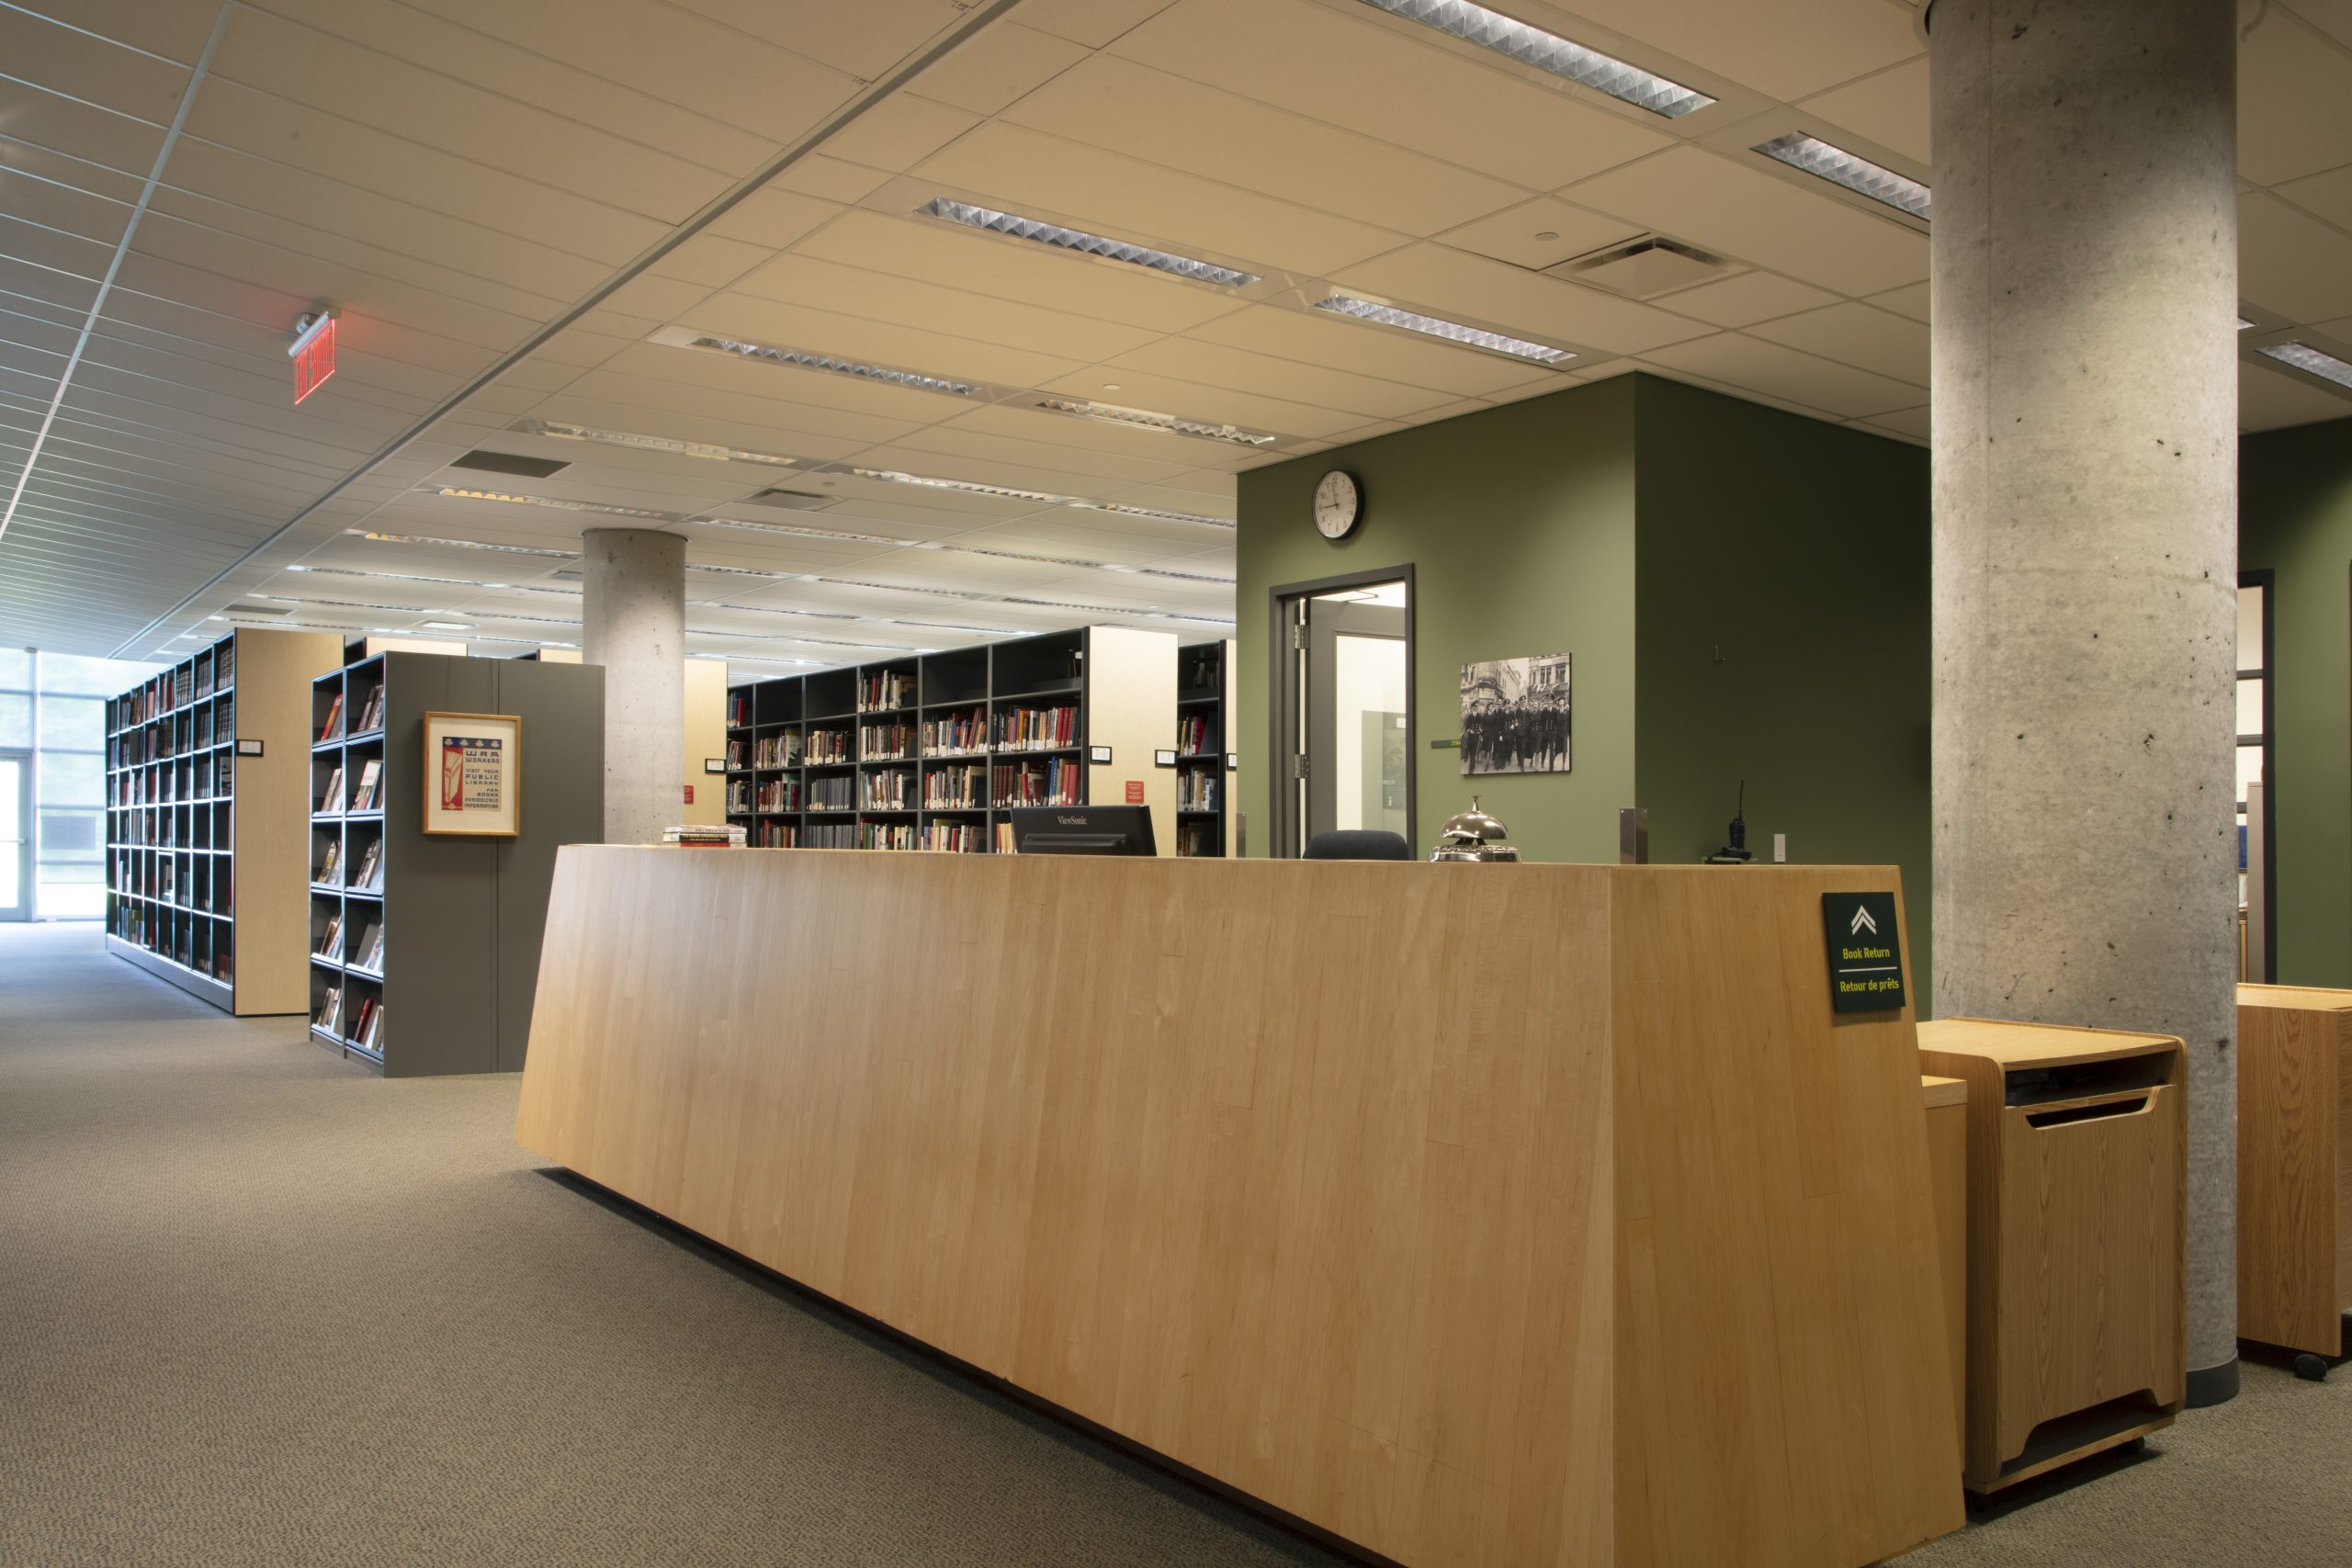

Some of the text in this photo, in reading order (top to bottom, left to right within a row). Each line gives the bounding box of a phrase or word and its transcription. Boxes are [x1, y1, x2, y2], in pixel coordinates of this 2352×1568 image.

[1057, 816, 1087, 824] ViewSonic
[1842, 947, 1890, 959] Book Return
[1839, 977, 1899, 993] Retour de prêts
